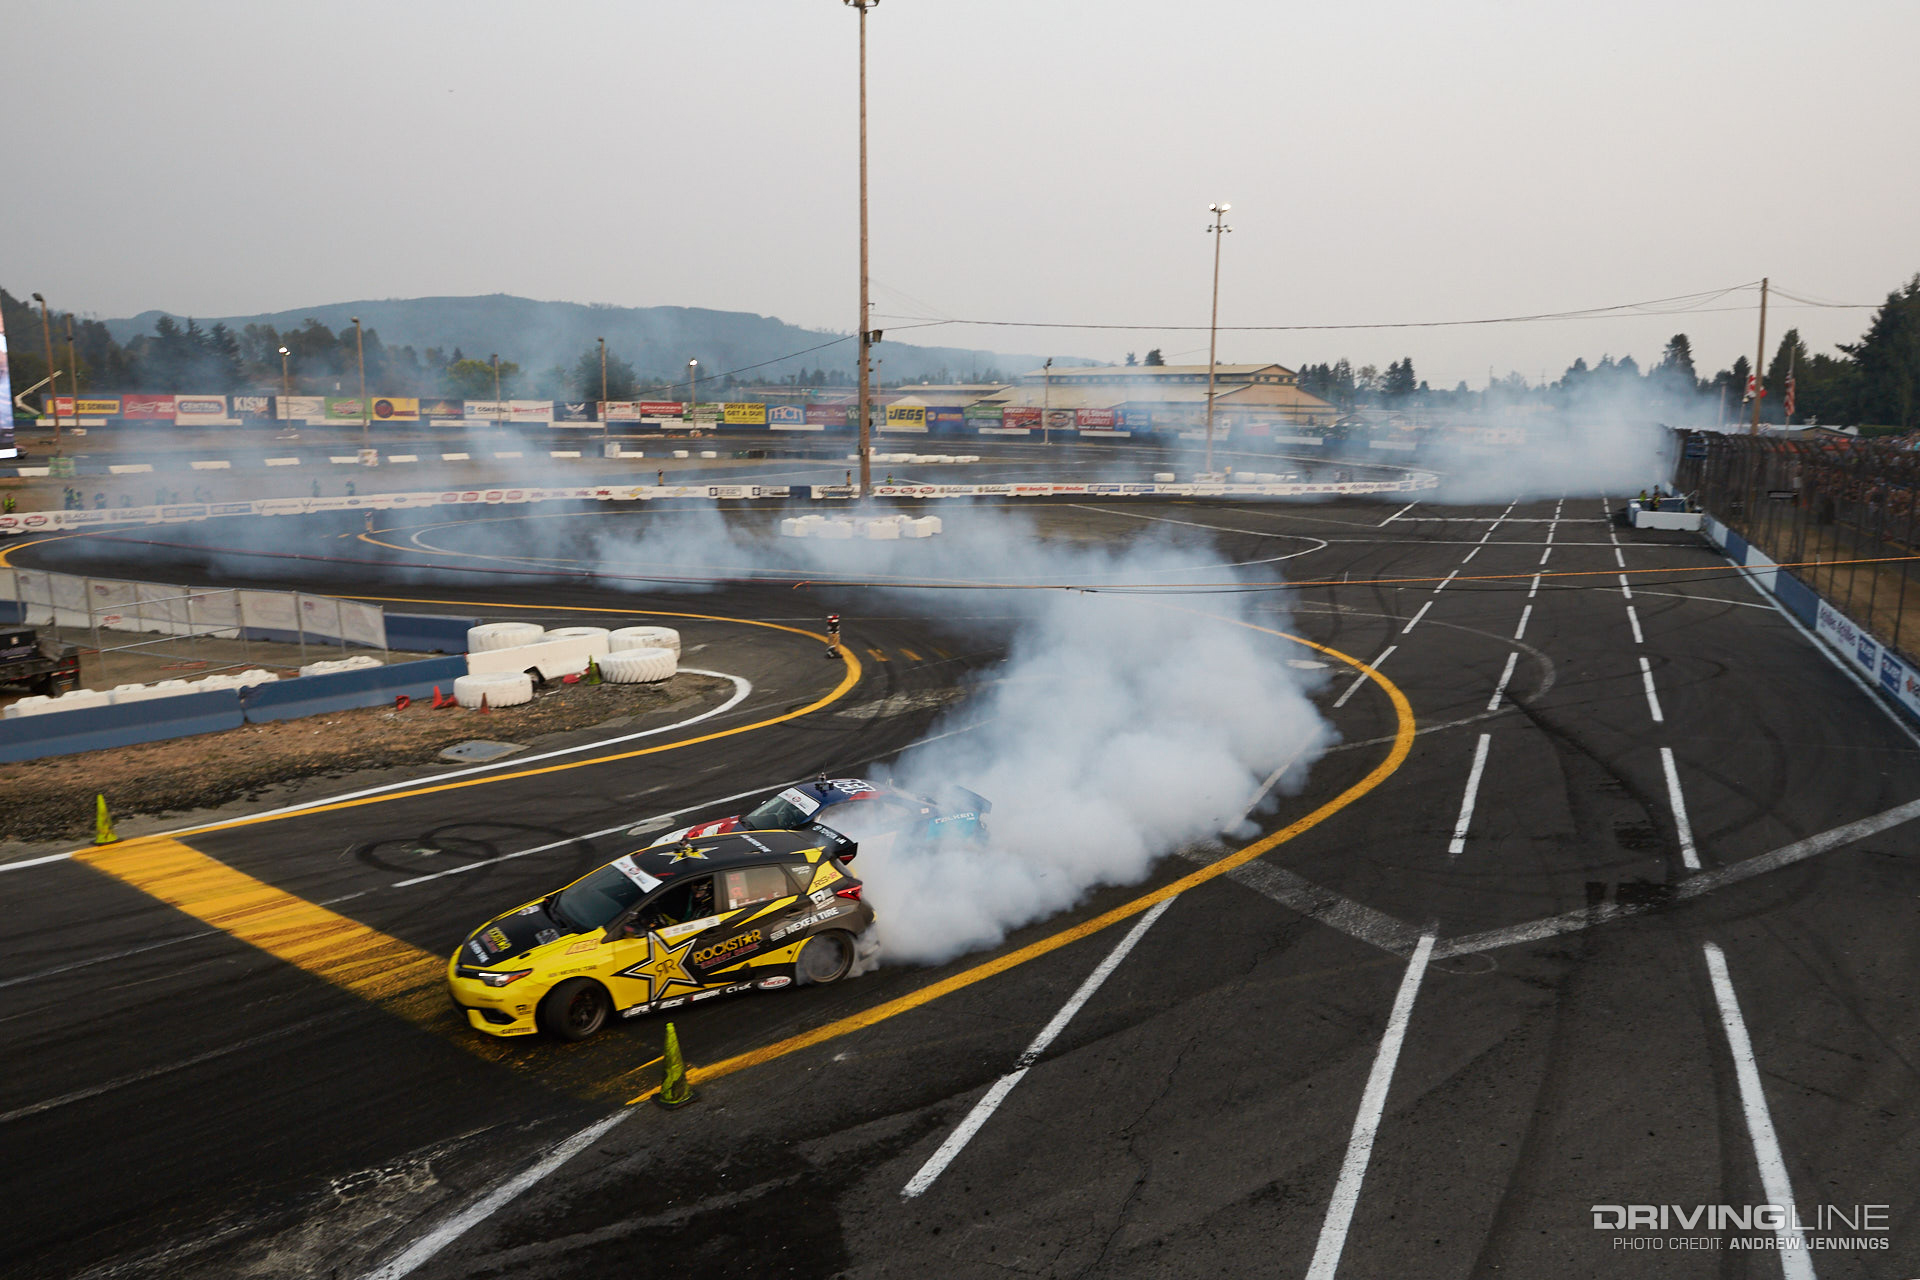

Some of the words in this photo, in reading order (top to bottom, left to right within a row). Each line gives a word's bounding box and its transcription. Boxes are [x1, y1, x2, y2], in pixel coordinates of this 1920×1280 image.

[889, 409, 923, 420] JEGS
[786, 915, 819, 935] NEXEN
[817, 906, 840, 920] TIRE
